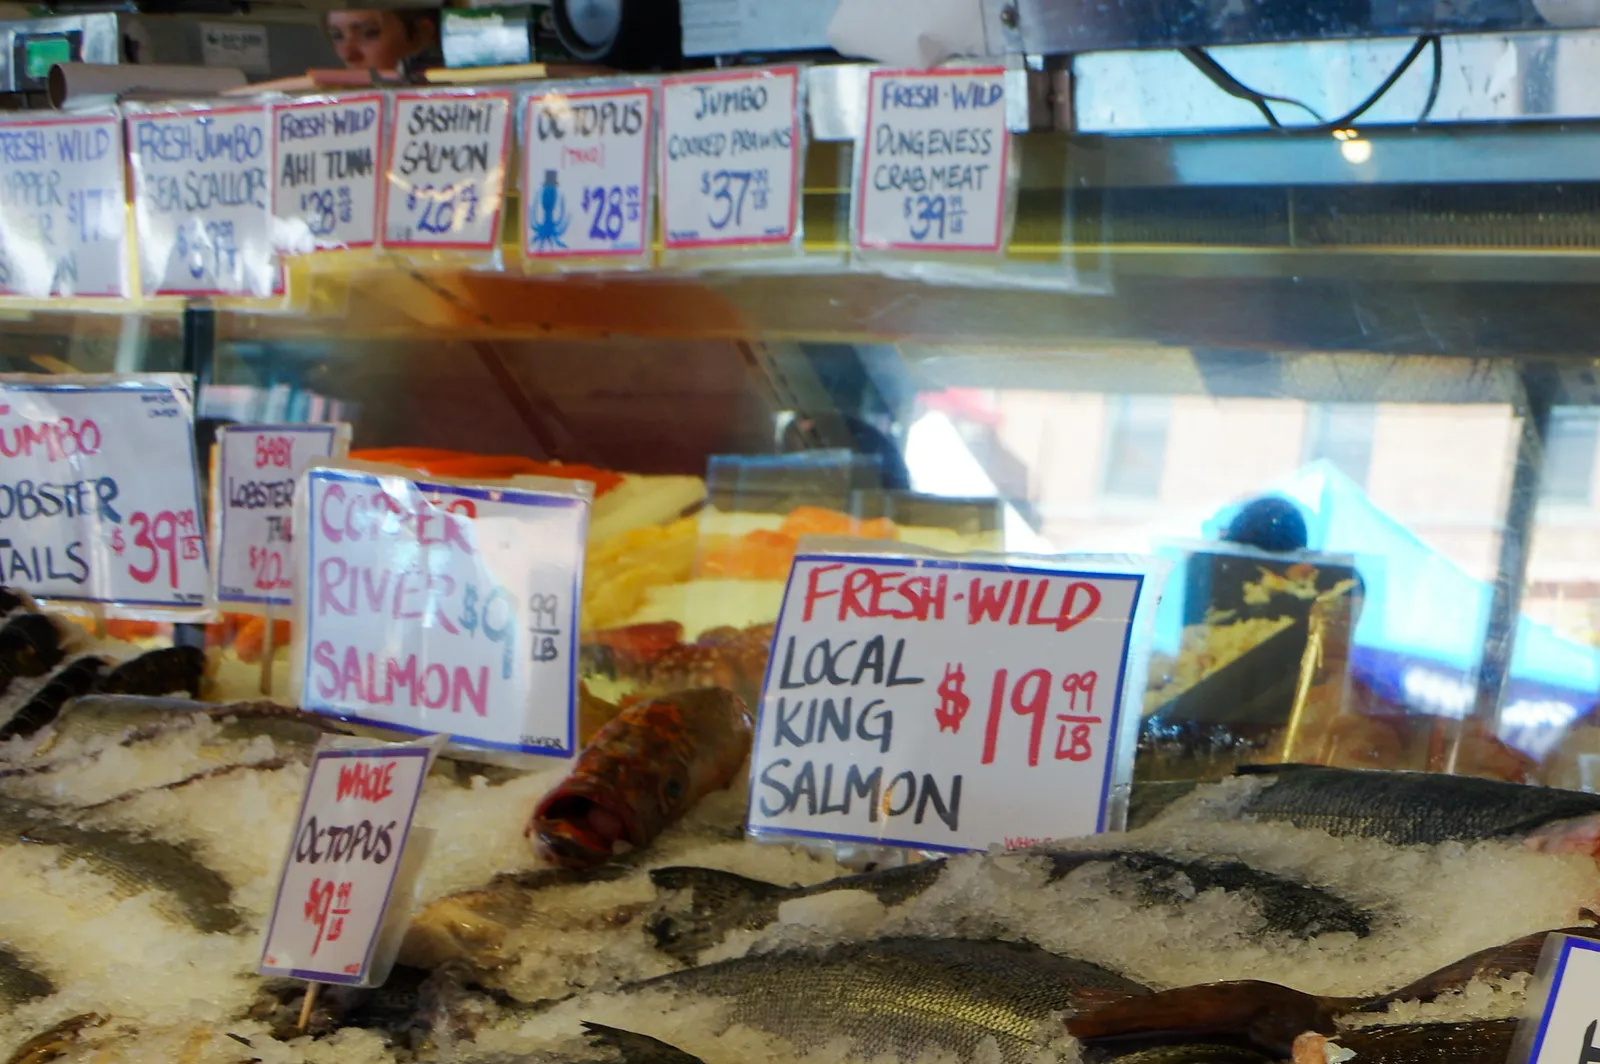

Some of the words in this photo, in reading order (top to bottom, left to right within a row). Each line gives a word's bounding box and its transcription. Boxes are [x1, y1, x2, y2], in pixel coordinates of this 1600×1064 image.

[407, 104, 493, 135] SASHIMI
[538, 100, 642, 141] OCTOPUS
[693, 85, 767, 120] JUMBO
[0, 130, 46, 164] RESH
[57, 127, 111, 162] WILD
[400, 140, 491, 175] SALMON
[876, 124, 992, 159] DUNGENESS
[281, 152, 317, 188] AHI
[0, 477, 121, 524] OBSTER
[229, 477, 296, 509] LOBSTER
[319, 557, 460, 636] RIVER
[313, 640, 490, 718] SALMON
[779, 634, 925, 690] LOCAL
[774, 697, 894, 753] KING
[336, 760, 397, 803] WHOLE
[759, 758, 963, 832] SALMON
[296, 815, 397, 865] OCTOPUS
